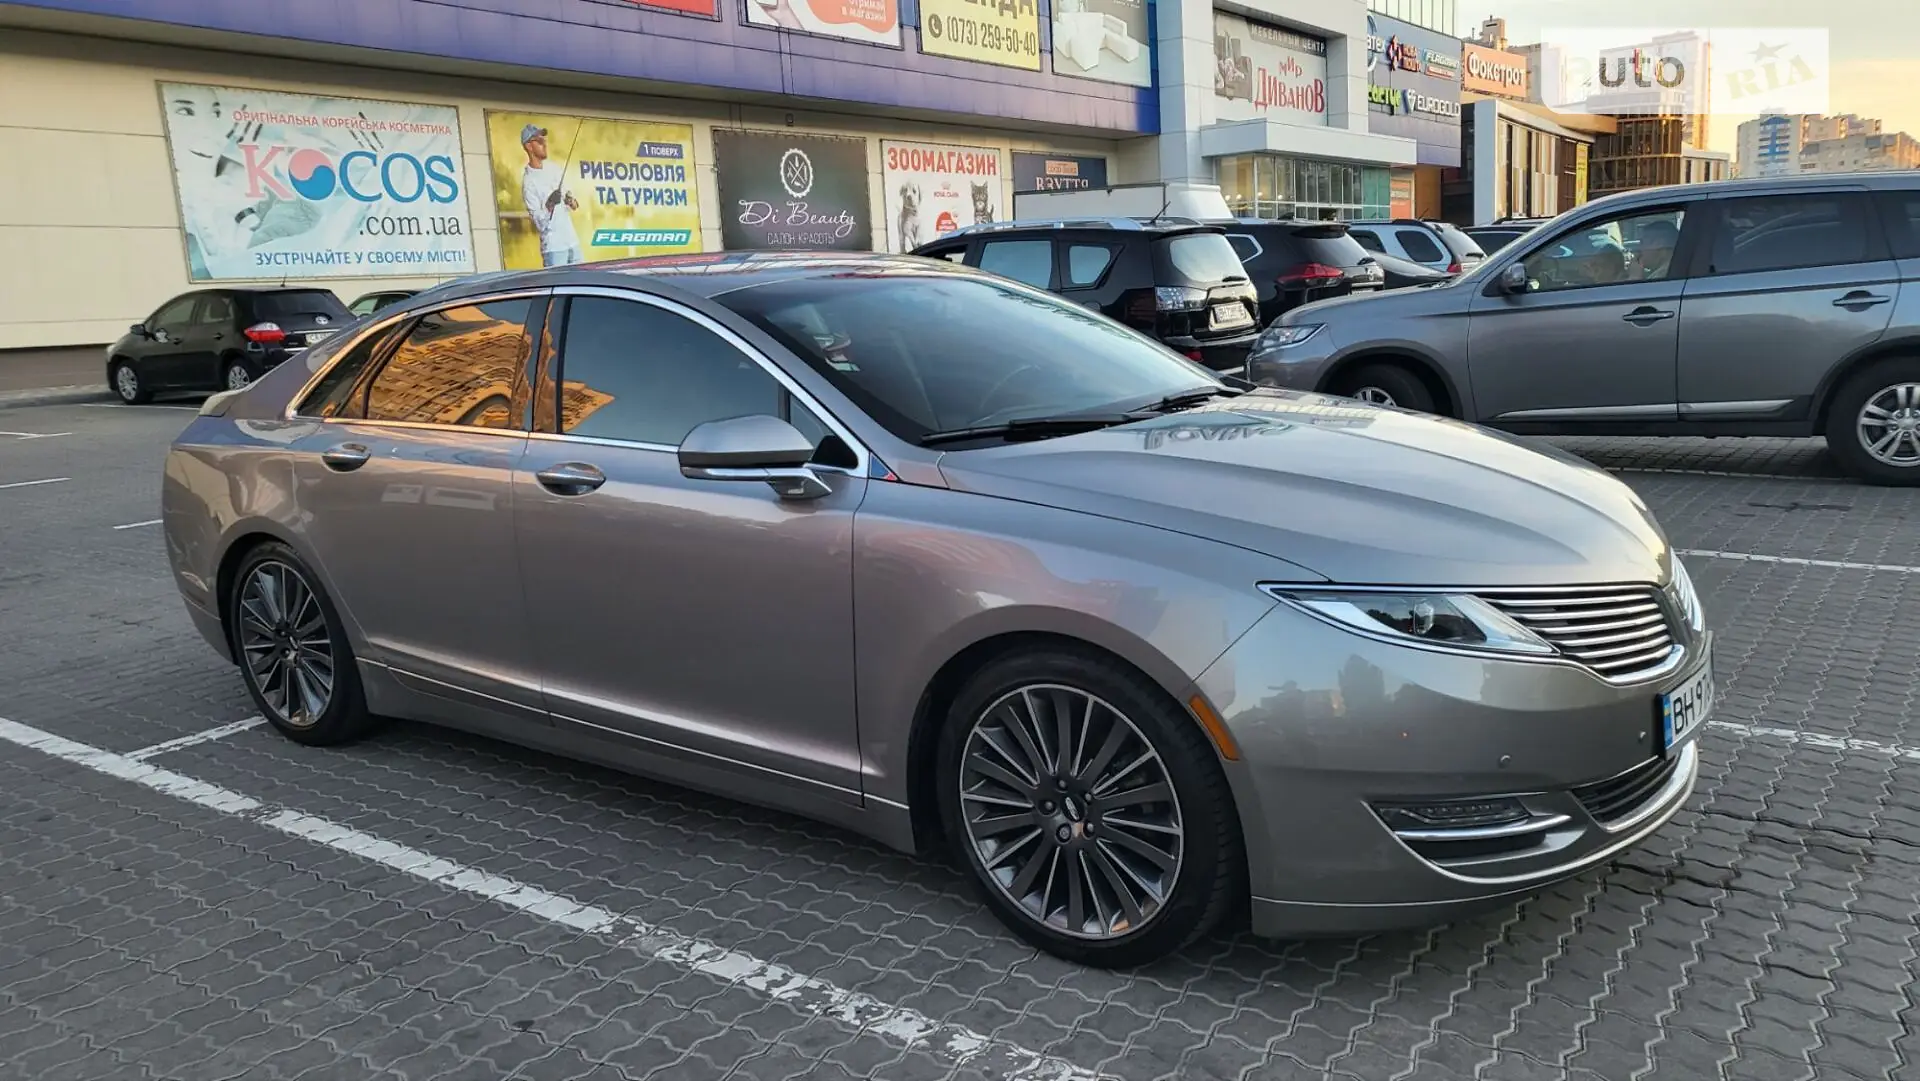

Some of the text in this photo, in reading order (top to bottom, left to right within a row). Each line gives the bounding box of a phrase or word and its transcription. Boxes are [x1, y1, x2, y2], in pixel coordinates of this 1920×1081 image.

[946, 15, 1036, 57] (073) 259-50-40
[232, 110, 452, 136] ОРИГІНАЛЬНА КОРЕЙСЬКА КОСМЕТИКА
[643, 143, 679, 156] 1 ПОВЕРХ
[580, 160, 686, 182] РИБОЛОВЛЯ
[887, 147, 997, 176] ЗООМАГАЗИН
[595, 186, 688, 206] ТА ТУРИЗМ
[358, 215, 463, 237] .com.ua
[738, 199, 857, 238] Di Beauty
[595, 232, 688, 243] FLAGMAN
[767, 232, 796, 245] САЛОН
[255, 249, 467, 266] ЗУСТРІЧАЙТЕ У СВОЄМУ МІСТІ!
